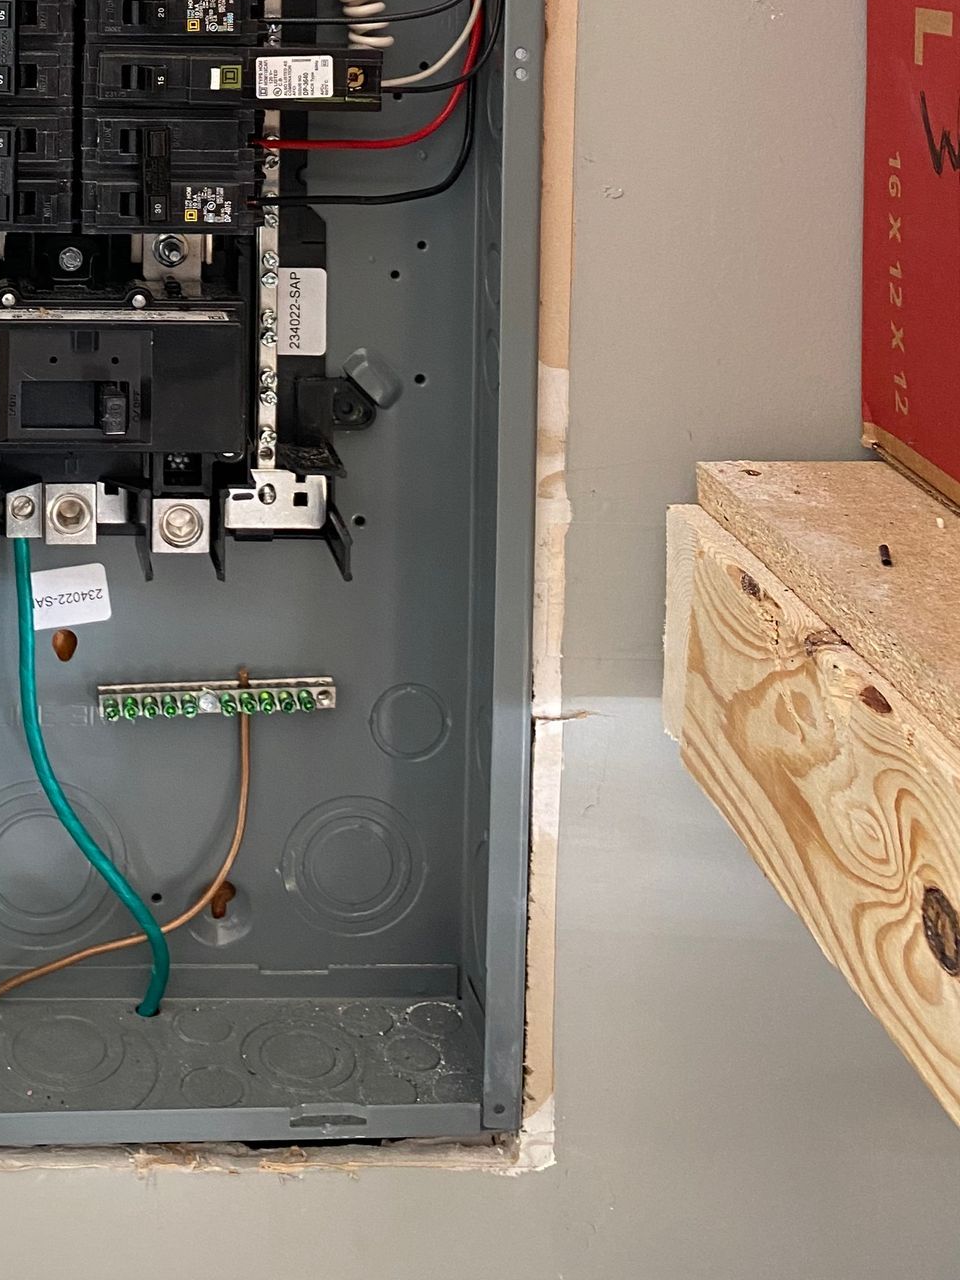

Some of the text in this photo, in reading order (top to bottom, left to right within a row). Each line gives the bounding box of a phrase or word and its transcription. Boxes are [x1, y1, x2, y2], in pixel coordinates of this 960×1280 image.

[158, 8, 164, 17] 20
[157, 76, 164, 85] 15
[888, 152, 901, 198] 16
[155, 204, 161, 213] 30
[889, 261, 902, 307] 12
[289, 272, 300, 349] 234022-SAP
[894, 371, 909, 415] 12
[32, 589, 103, 609] 234022-SA
